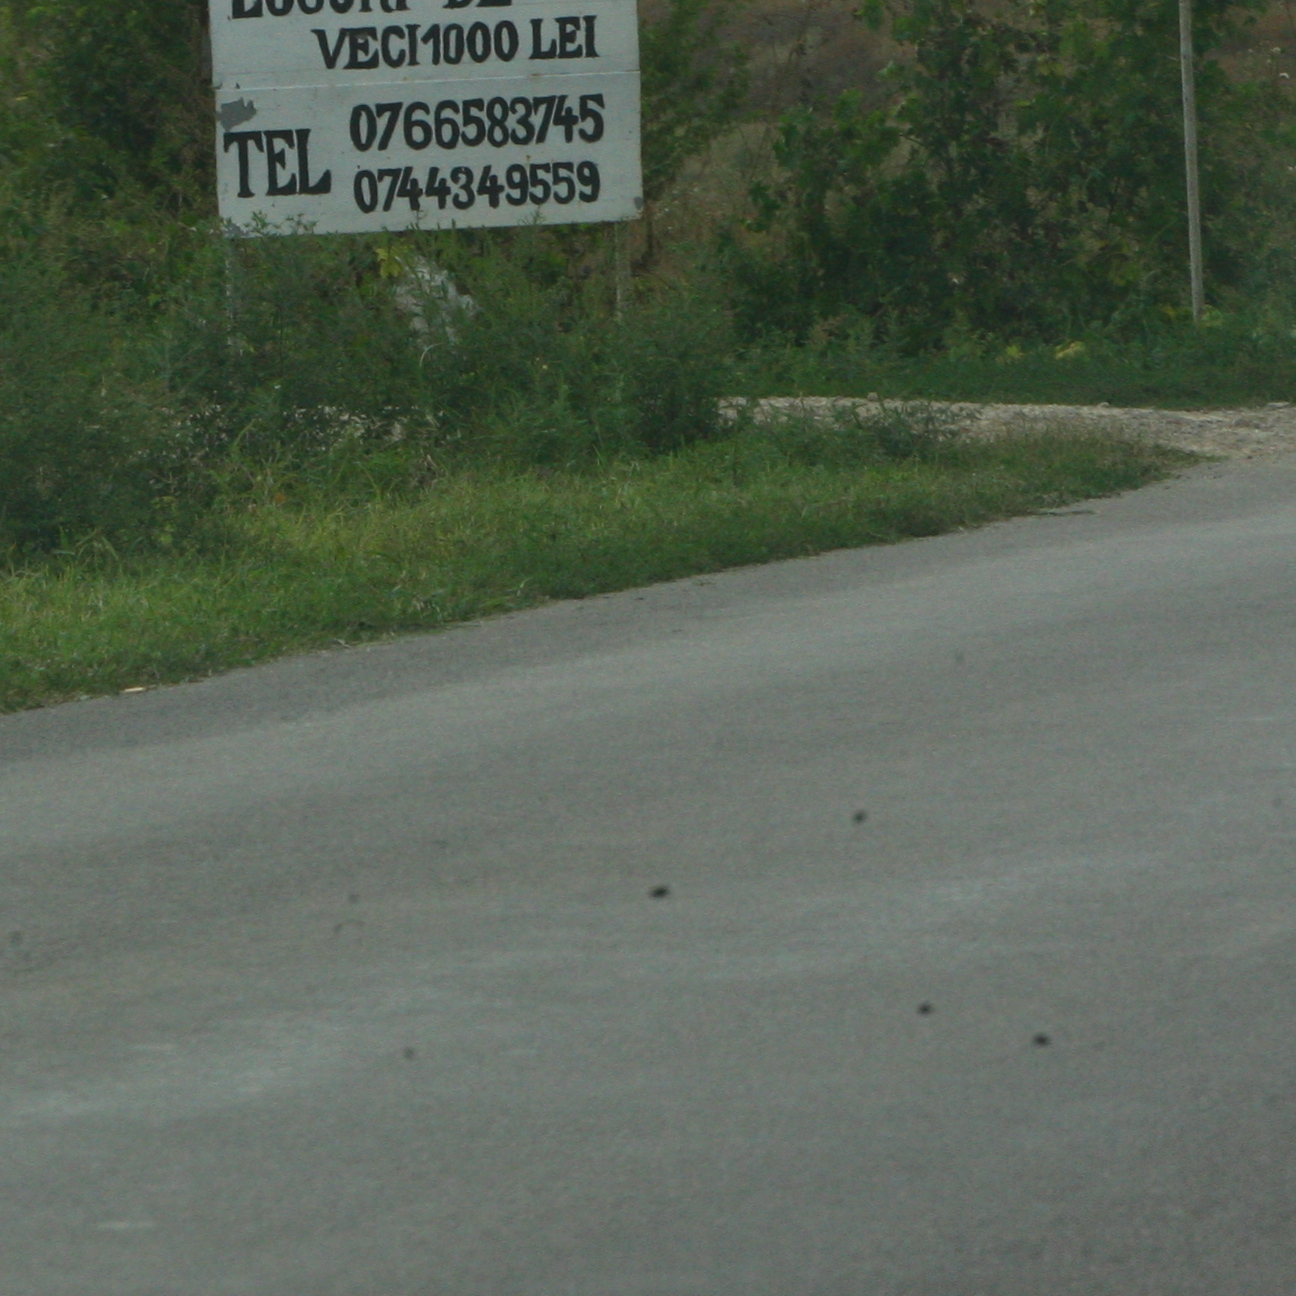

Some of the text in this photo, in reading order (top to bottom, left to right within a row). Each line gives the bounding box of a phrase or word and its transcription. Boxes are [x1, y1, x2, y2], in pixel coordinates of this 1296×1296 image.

[529, 15, 599, 60] LEI
[350, 94, 605, 152] 0766583745
[223, 128, 331, 198] TEL
[354, 161, 600, 214] 0744349559
